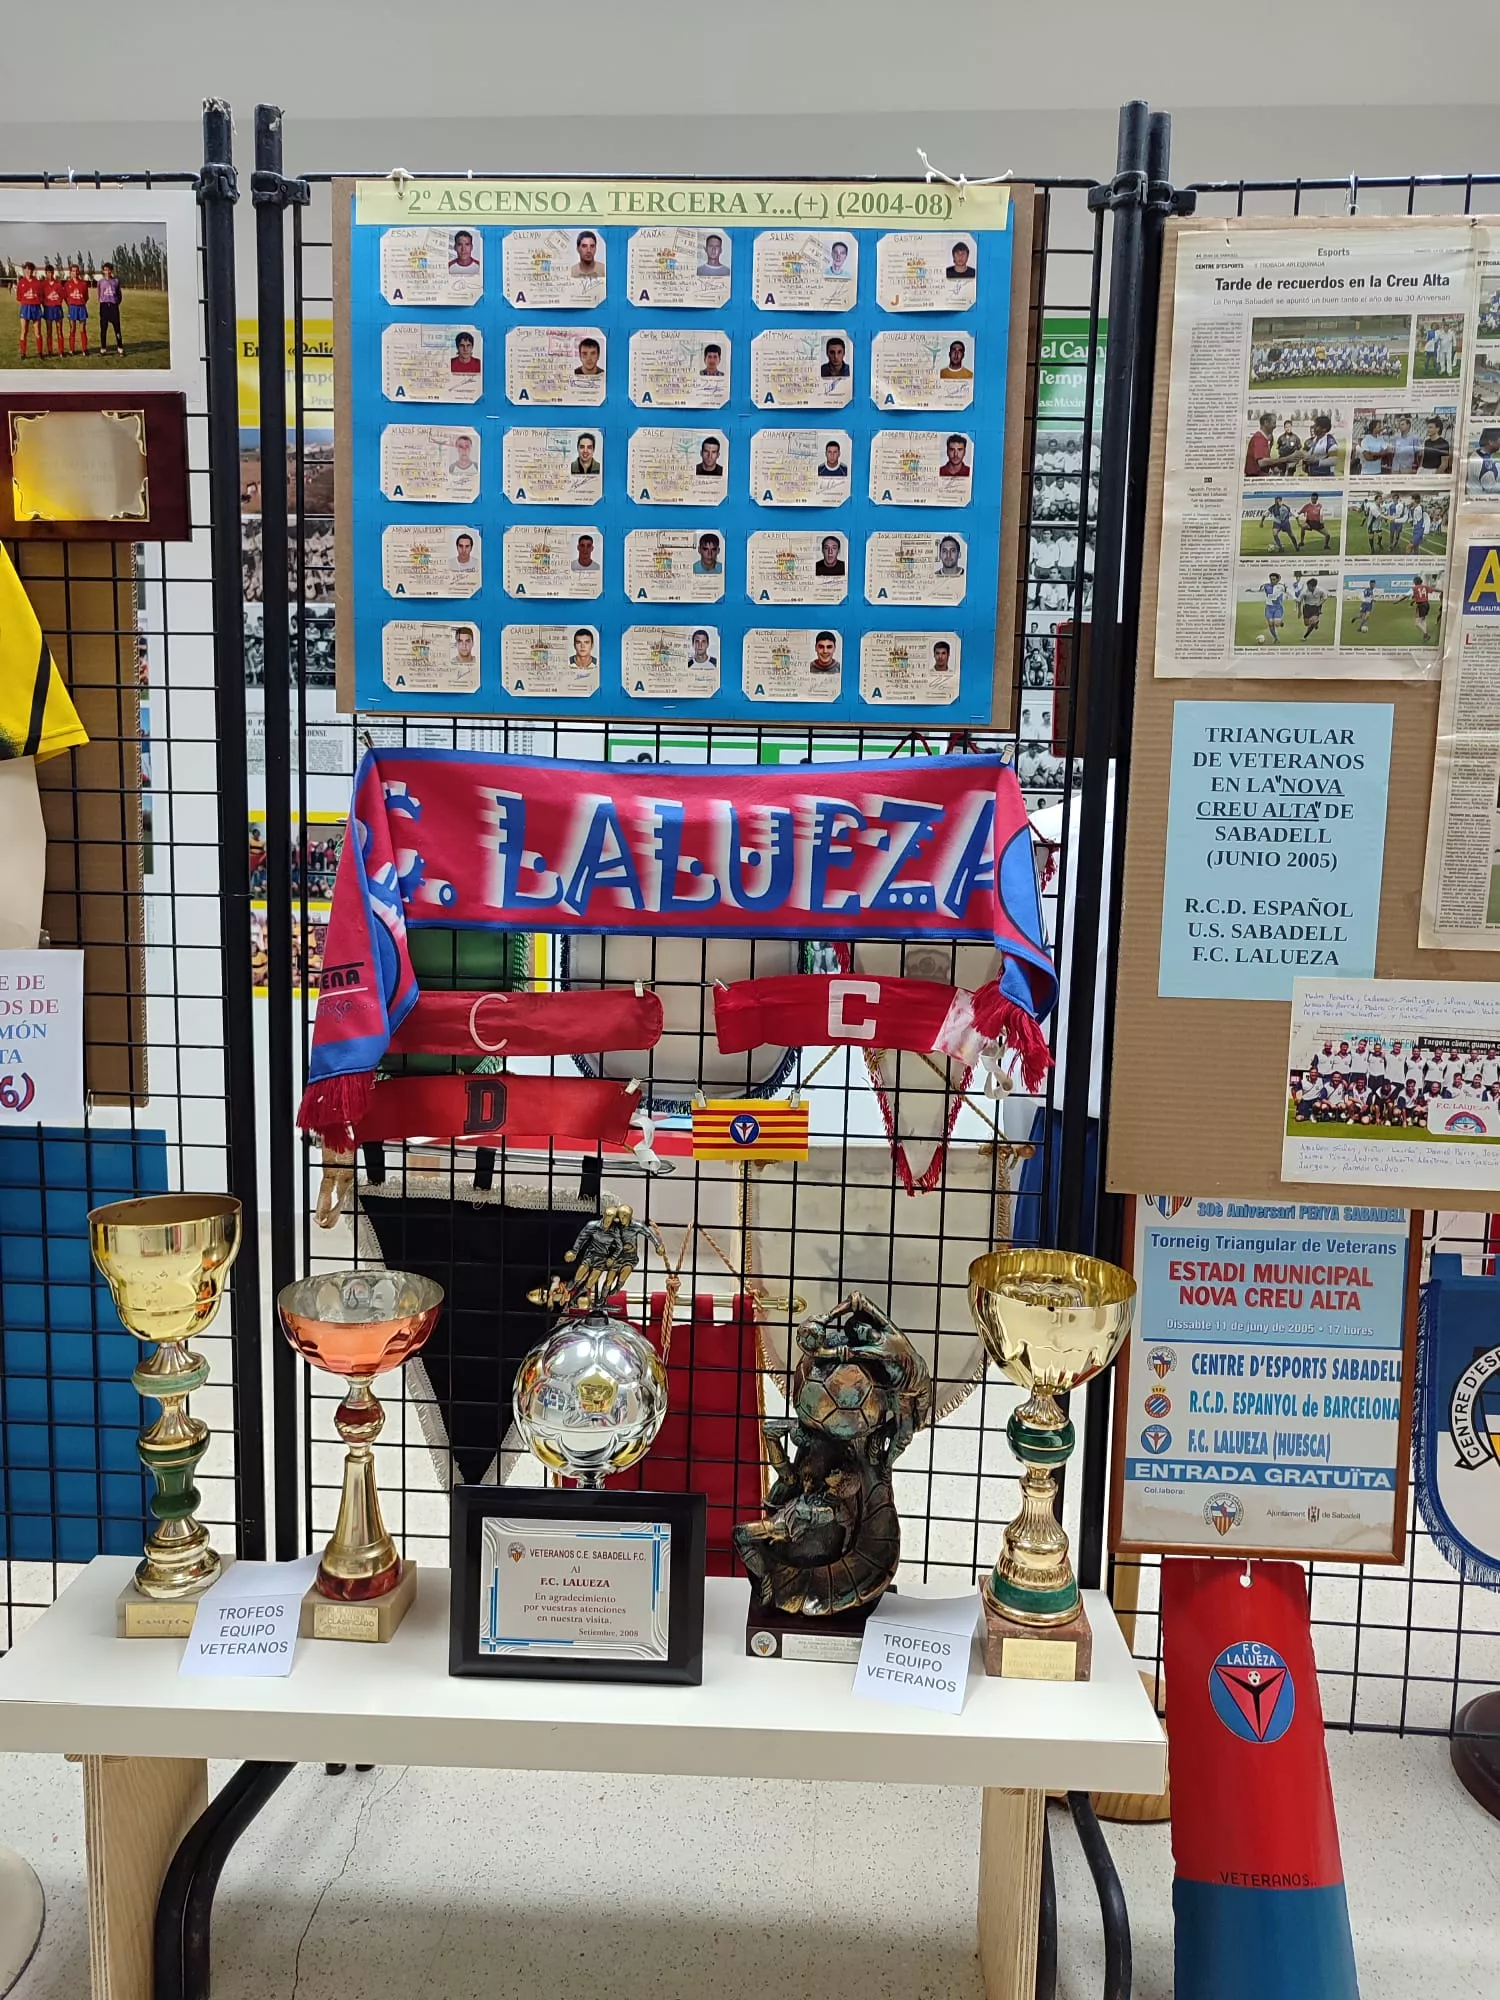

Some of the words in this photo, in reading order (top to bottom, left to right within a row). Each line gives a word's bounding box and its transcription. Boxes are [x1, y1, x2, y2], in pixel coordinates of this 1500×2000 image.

[408, 190, 431, 211] 2º
[437, 190, 571, 213] ASCENSO
[577, 191, 598, 213] A
[607, 191, 748, 213] TERCERA
[836, 191, 952, 220] (2004-08)
[1318, 248, 1350, 257] Esports
[1215, 277, 1252, 291] Tarde
[1256, 276, 1272, 290] de
[1277, 275, 1344, 289] recuerdos
[1349, 276, 1364, 288] en
[1370, 274, 1381, 287] la
[1387, 274, 1418, 287] Creu
[1423, 273, 1449, 287] Alta
[394, 289, 403, 299] A
[765, 293, 776, 304] A
[764, 392, 775, 404] A
[884, 394, 895, 405] A
[516, 488, 526, 499] A
[763, 490, 773, 501] A
[759, 590, 770, 601] A
[1418, 588, 1427, 598] 14
[396, 675, 406, 686] A
[1205, 727, 1356, 745] TRIANGULAR
[1192, 751, 1222, 767] DE
[1229, 752, 1365, 770] VETERANOS
[1211, 776, 1240, 792] EN
[1196, 801, 1257, 818] CREU
[1325, 803, 1354, 819] DE
[1215, 825, 1332, 844] SABADELL
[477, 784, 996, 916] LALUEZA
[1207, 850, 1280, 869] (JUNIO
[1287, 852, 1338, 873] 2005)
[1185, 898, 1246, 914] R.C.D.
[1253, 897, 1353, 918] ESPAÑOL
[1188, 922, 1225, 938] U.S.
[1231, 923, 1348, 942] SABADELL
[1192, 946, 1229, 962] F.C.
[1235, 947, 1339, 966] LALUEZA
[16, 975, 45, 990] DE
[29, 999, 59, 1014] DE
[828, 979, 882, 1040] C
[470, 993, 509, 1052] C
[464, 1080, 507, 1134] D
[1197, 1202, 1224, 1218] 30è
[1227, 1203, 1295, 1219] Aniversari
[1300, 1205, 1340, 1221] PENYA
[1343, 1206, 1406, 1223] SABADELL
[1151, 1233, 1210, 1252] Torneig
[1216, 1235, 1297, 1254] Triangular
[1302, 1238, 1321, 1252] de
[1327, 1239, 1397, 1255] Veterans
[1169, 1260, 1245, 1283] ESTADI
[1253, 1263, 1374, 1287] MUNICIPAL
[1180, 1285, 1238, 1307] NOVA
[1244, 1287, 1303, 1309] CREU
[1310, 1289, 1361, 1310] ALTA
[1166, 1318, 1212, 1331] Dissabte
[1216, 1319, 1227, 1330] 11
[1231, 1320, 1243, 1331] de
[1246, 1322, 1269, 1334] juny
[1273, 1322, 1285, 1332] de
[1288, 1323, 1315, 1334] 2005
[1328, 1325, 1341, 1335] 17
[1344, 1325, 1374, 1336] hores
[1191, 1353, 1245, 1377] CENTRE
[1250, 1355, 1327, 1380] D'ESPORTS
[1189, 1390, 1228, 1414] R.C.D.
[1232, 1392, 1298, 1417] ESPANYOL
[1302, 1394, 1319, 1418] de
[1323, 1395, 1400, 1420] BARCELONA
[1455, 1391, 1480, 1459] CENTRE
[1188, 1429, 1209, 1453] F.C.
[1213, 1430, 1268, 1455] LALUEZA
[1273, 1430, 1331, 1464] (HUESCA)
[1135, 1463, 1257, 1482] ENTRADA
[1264, 1468, 1391, 1488] GRATUÏTA
[1266, 1510, 1305, 1519] Ajuntament
[1322, 1510, 1331, 1518] de
[1332, 1510, 1361, 1519] Sabadell
[530, 1549, 575, 1559] VETERANOS
[576, 1549, 589, 1559] C.E.
[592, 1550, 631, 1560] SABADELL
[634, 1552, 646, 1561] F.C.
[540, 1577, 559, 1586] F.C.
[563, 1578, 610, 1588] LALUEZA
[535, 1593, 546, 1601] En
[548, 1593, 616, 1603] agradecimiento
[218, 1605, 284, 1620] TROFEOS
[523, 1604, 538, 1612] por
[541, 1605, 577, 1613] vuestras
[580, 1605, 626, 1614] atenciones
[550, 1615, 583, 1623] nuestra
[586, 1615, 612, 1624] visita.
[219, 1623, 276, 1638] EQUIPO
[579, 1627, 618, 1637] Setiembre,
[619, 1629, 639, 1638] 2008
[200, 1641, 289, 1655] VETERANOS
[883, 1633, 952, 1656] TROFEOS
[885, 1652, 943, 1672] EQUIPO
[1226, 1654, 1277, 1666] LALUEZA
[866, 1664, 957, 1693] VETERANOS
